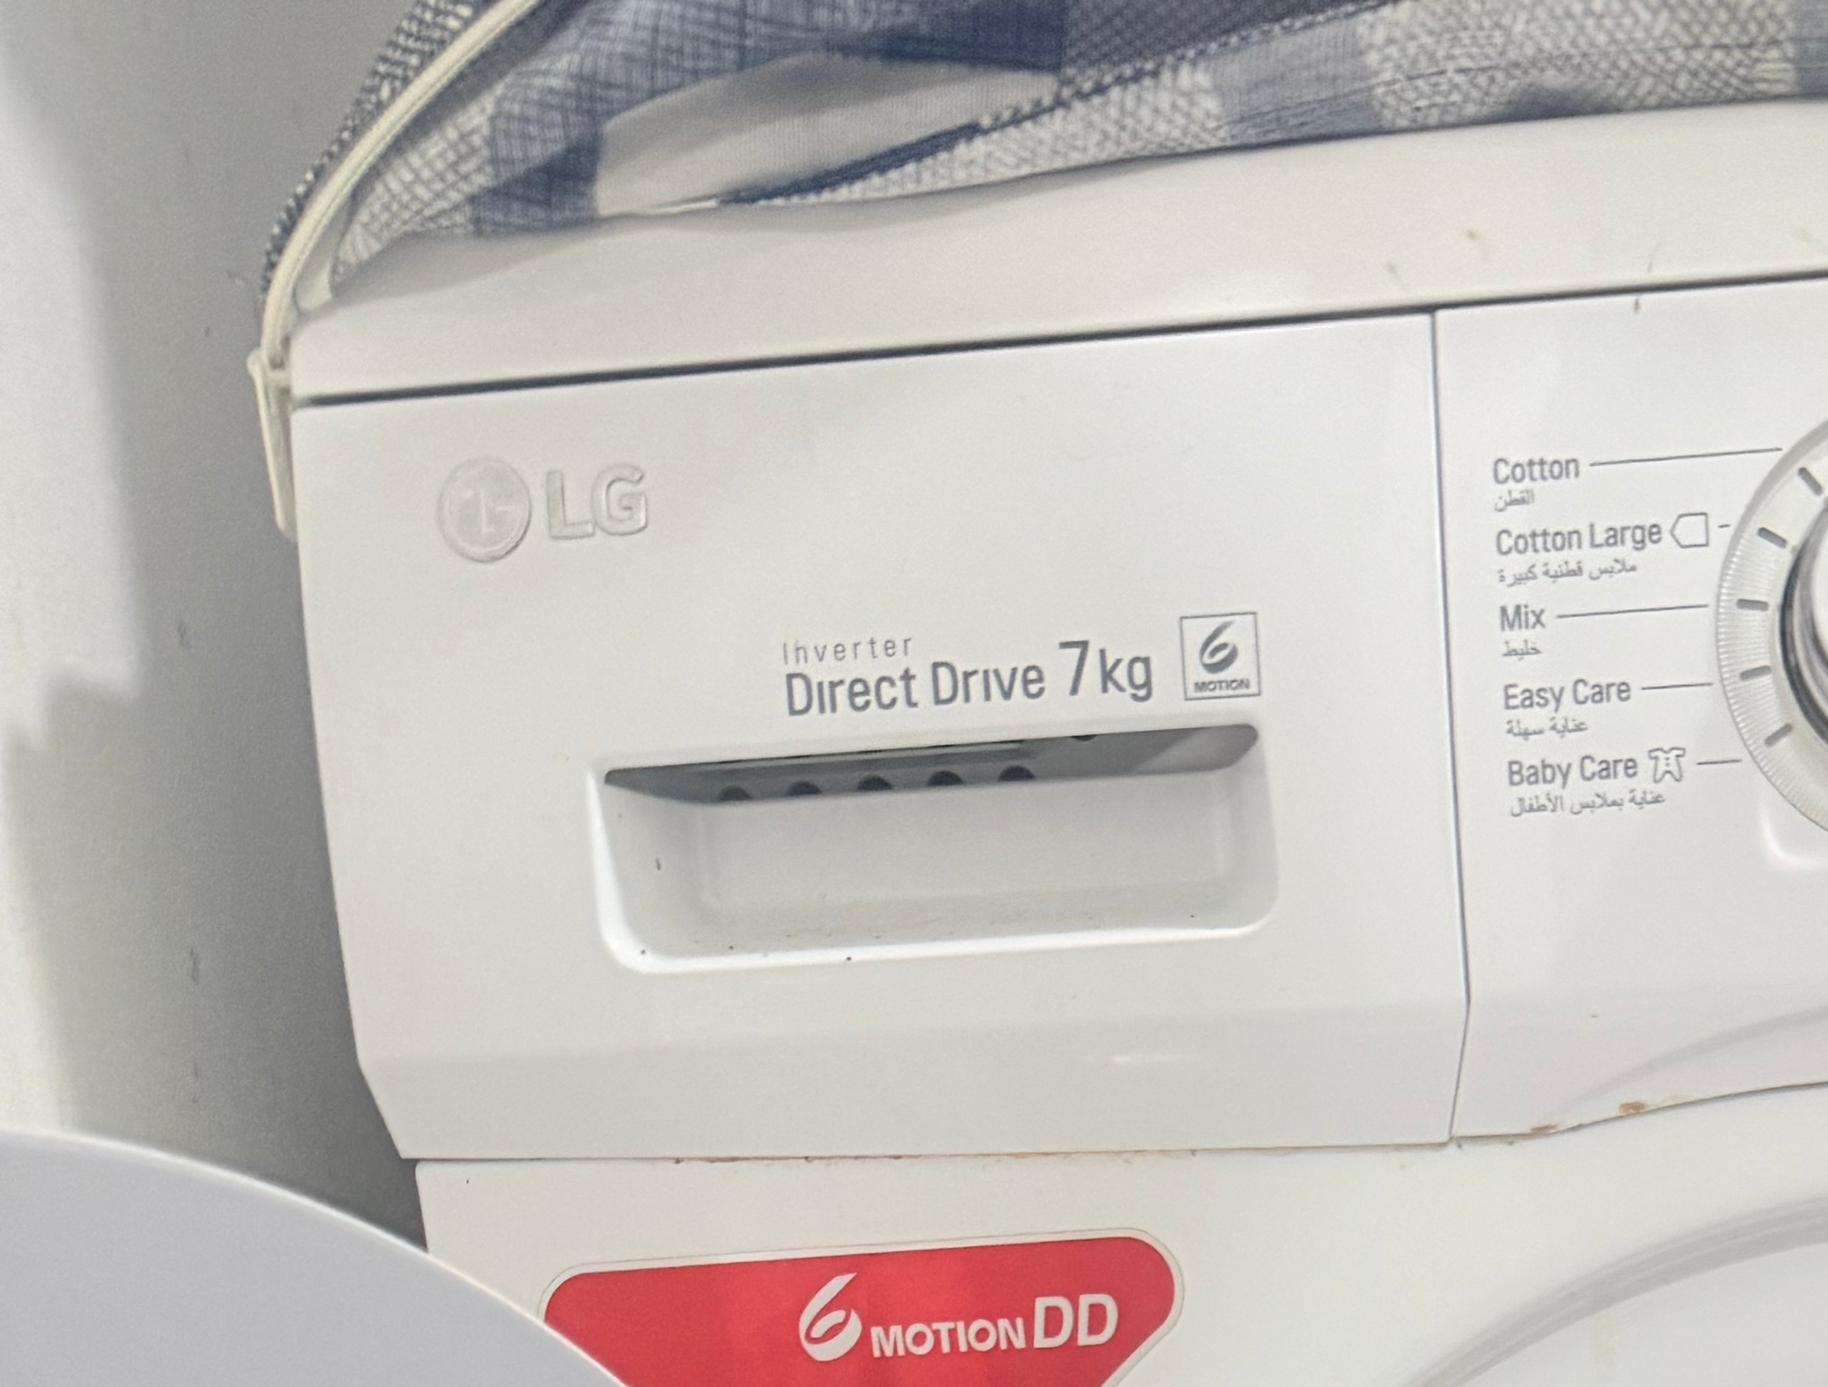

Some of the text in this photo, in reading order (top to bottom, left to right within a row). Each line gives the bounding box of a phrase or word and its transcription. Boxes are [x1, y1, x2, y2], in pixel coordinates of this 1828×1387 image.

[1492, 457, 1580, 485] Cotton
[546, 463, 648, 541] LG
[1494, 488, 1535, 512] القطن
[1496, 522, 1663, 556] Cotton Large
[1498, 558, 1638, 587] ملابس قطنية كبيرة
[1499, 604, 1547, 632] Mix
[782, 636, 913, 665] Inverter
[1502, 638, 1543, 661] خليط
[785, 667, 919, 717] Direct
[931, 660, 1046, 707] Drive
[1194, 677, 1251, 693] MOTION
[1503, 678, 1631, 713] Easy Care
[1550, 716, 1588, 739] عناية
[1507, 754, 1638, 790] Baby Care
[1629, 788, 1666, 810] عناية
